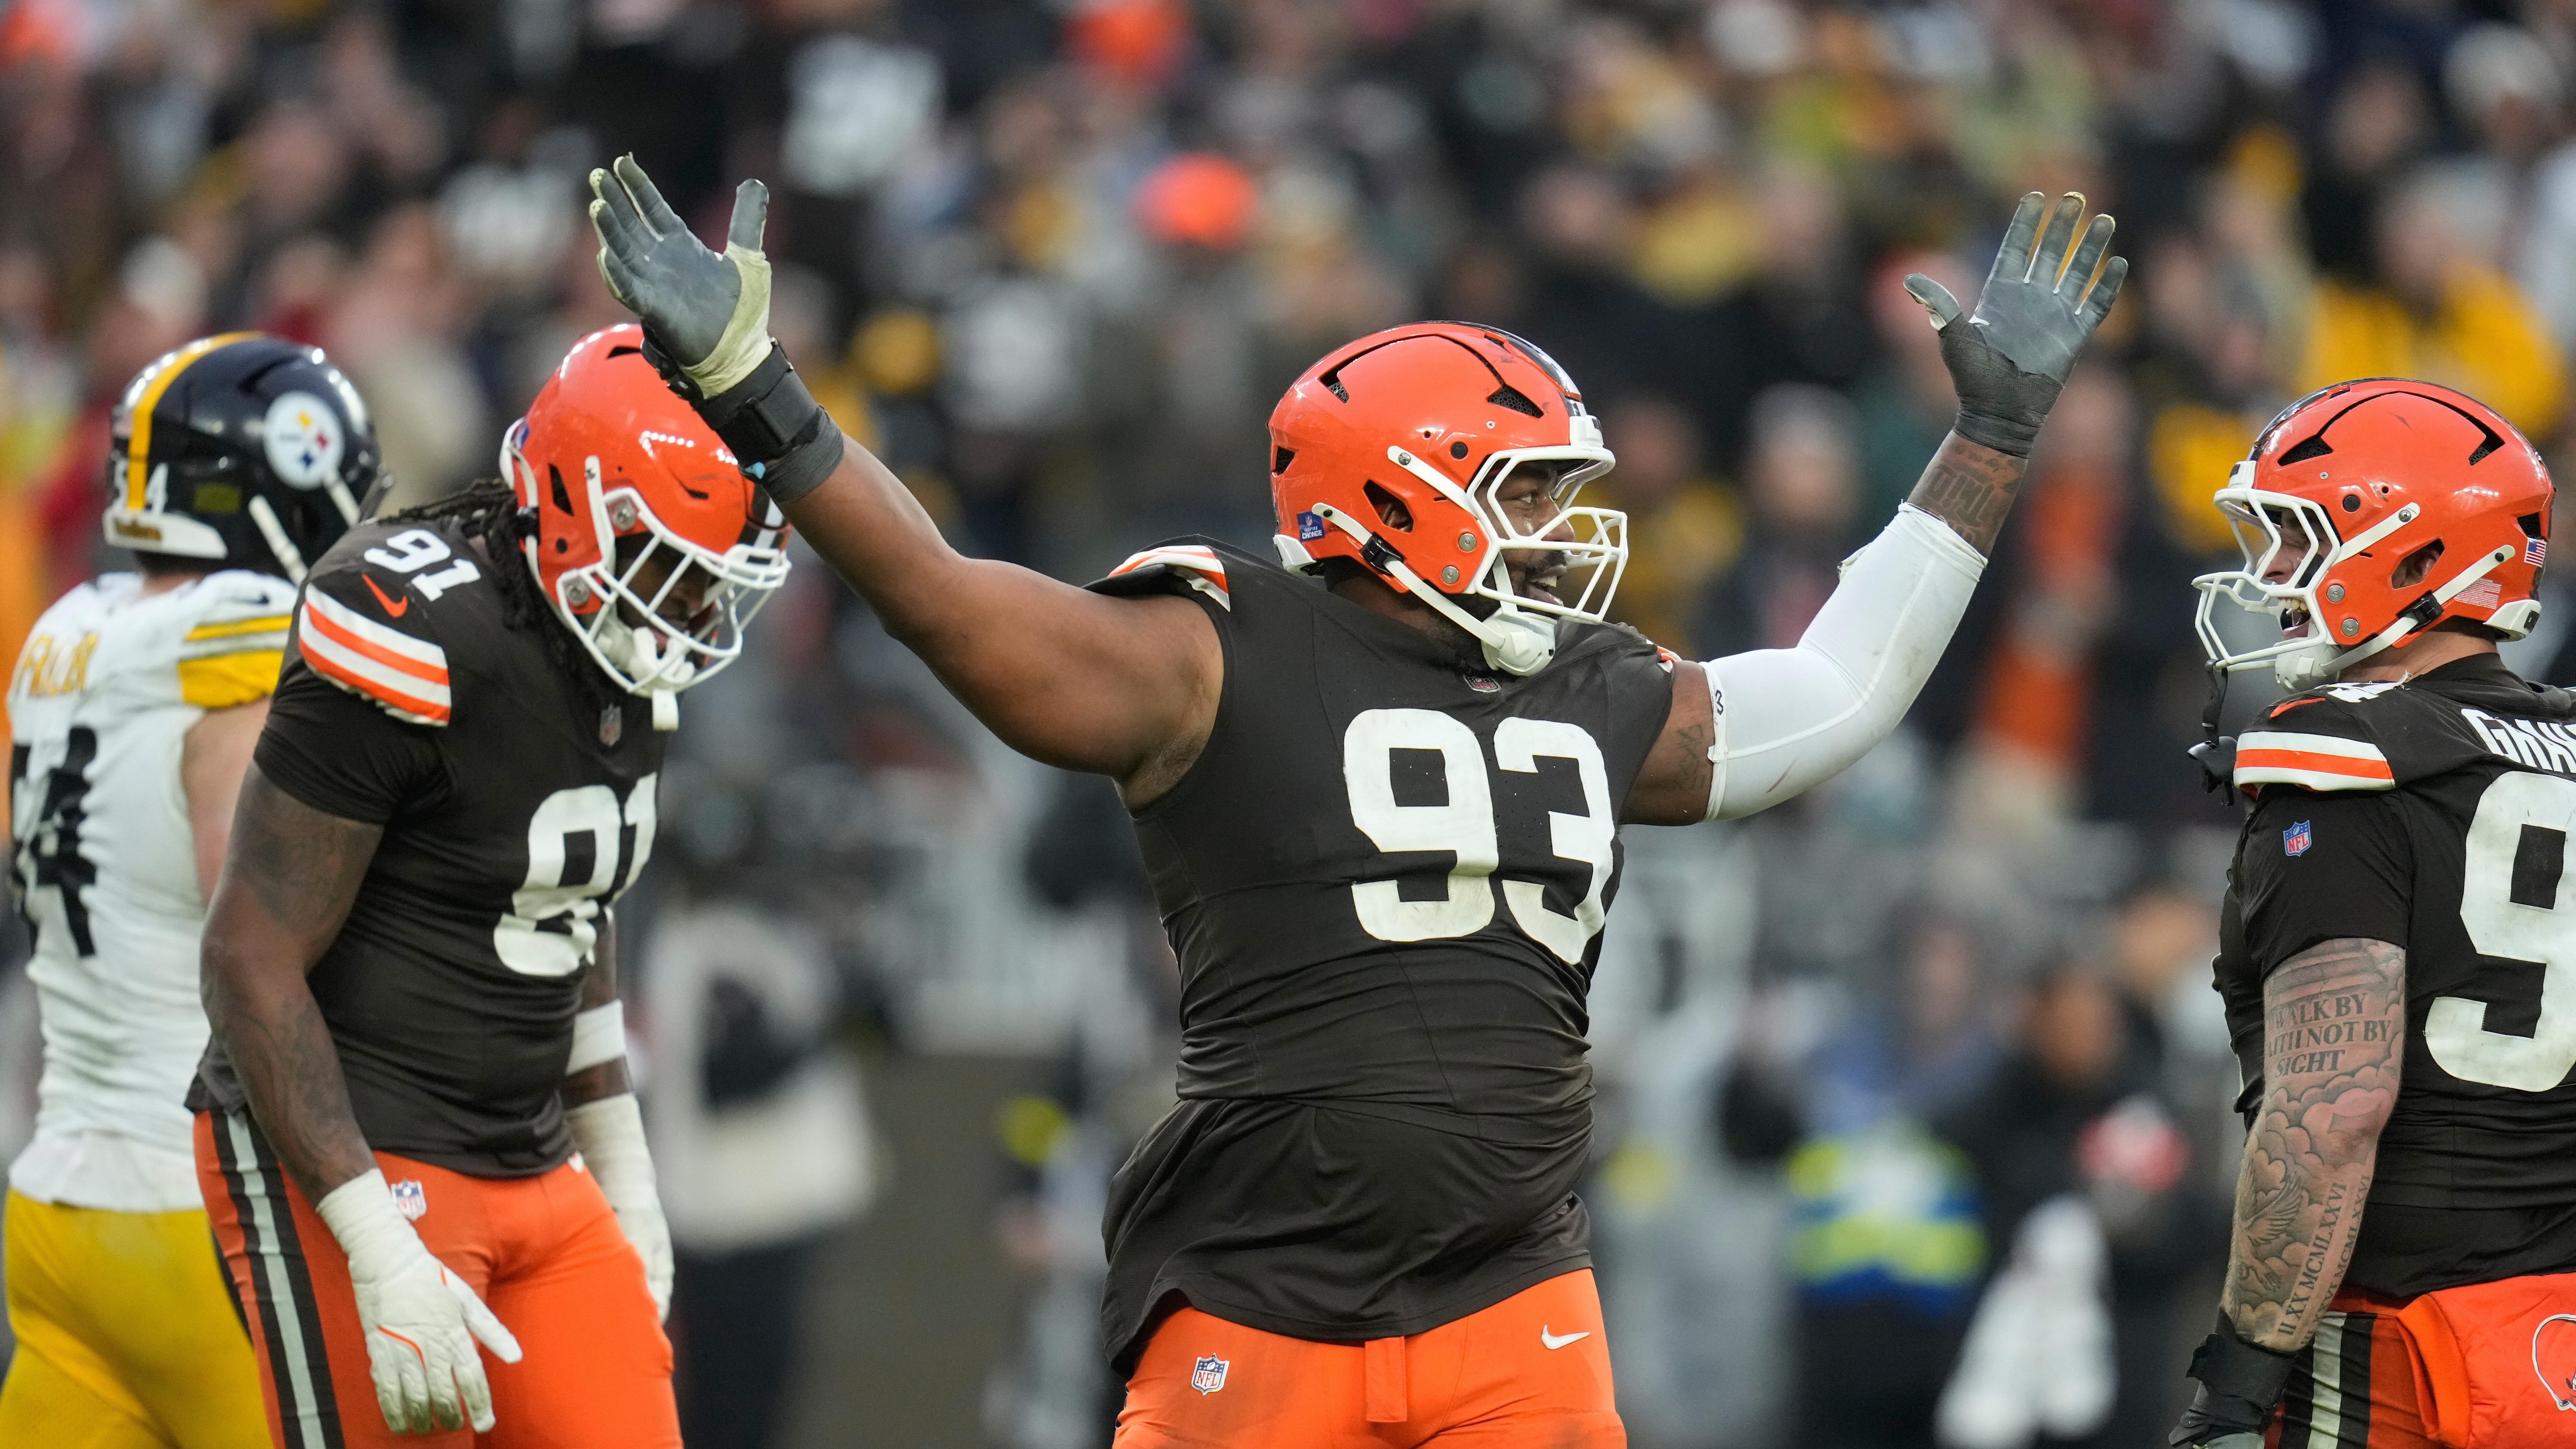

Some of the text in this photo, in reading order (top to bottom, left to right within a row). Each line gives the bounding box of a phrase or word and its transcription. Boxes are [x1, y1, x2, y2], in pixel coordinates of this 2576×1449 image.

[1302, 530, 1323, 539] CHANGE
[364, 529, 481, 602] 91
[2461, 708, 2576, 773] GRAH
[1343, 708, 1615, 965] 93
[2288, 833, 2309, 853] NFL
[2273, 993, 2368, 1029] WALK BY
[2306, 1021, 2359, 1047] NOT
[2362, 1020, 2392, 1042] BY
[2275, 1049, 2346, 1078] SIGHT
[2285, 1292, 2311, 1320] XX
[2278, 1321, 2297, 1336] II
[1196, 1371, 1217, 1387] NFL
